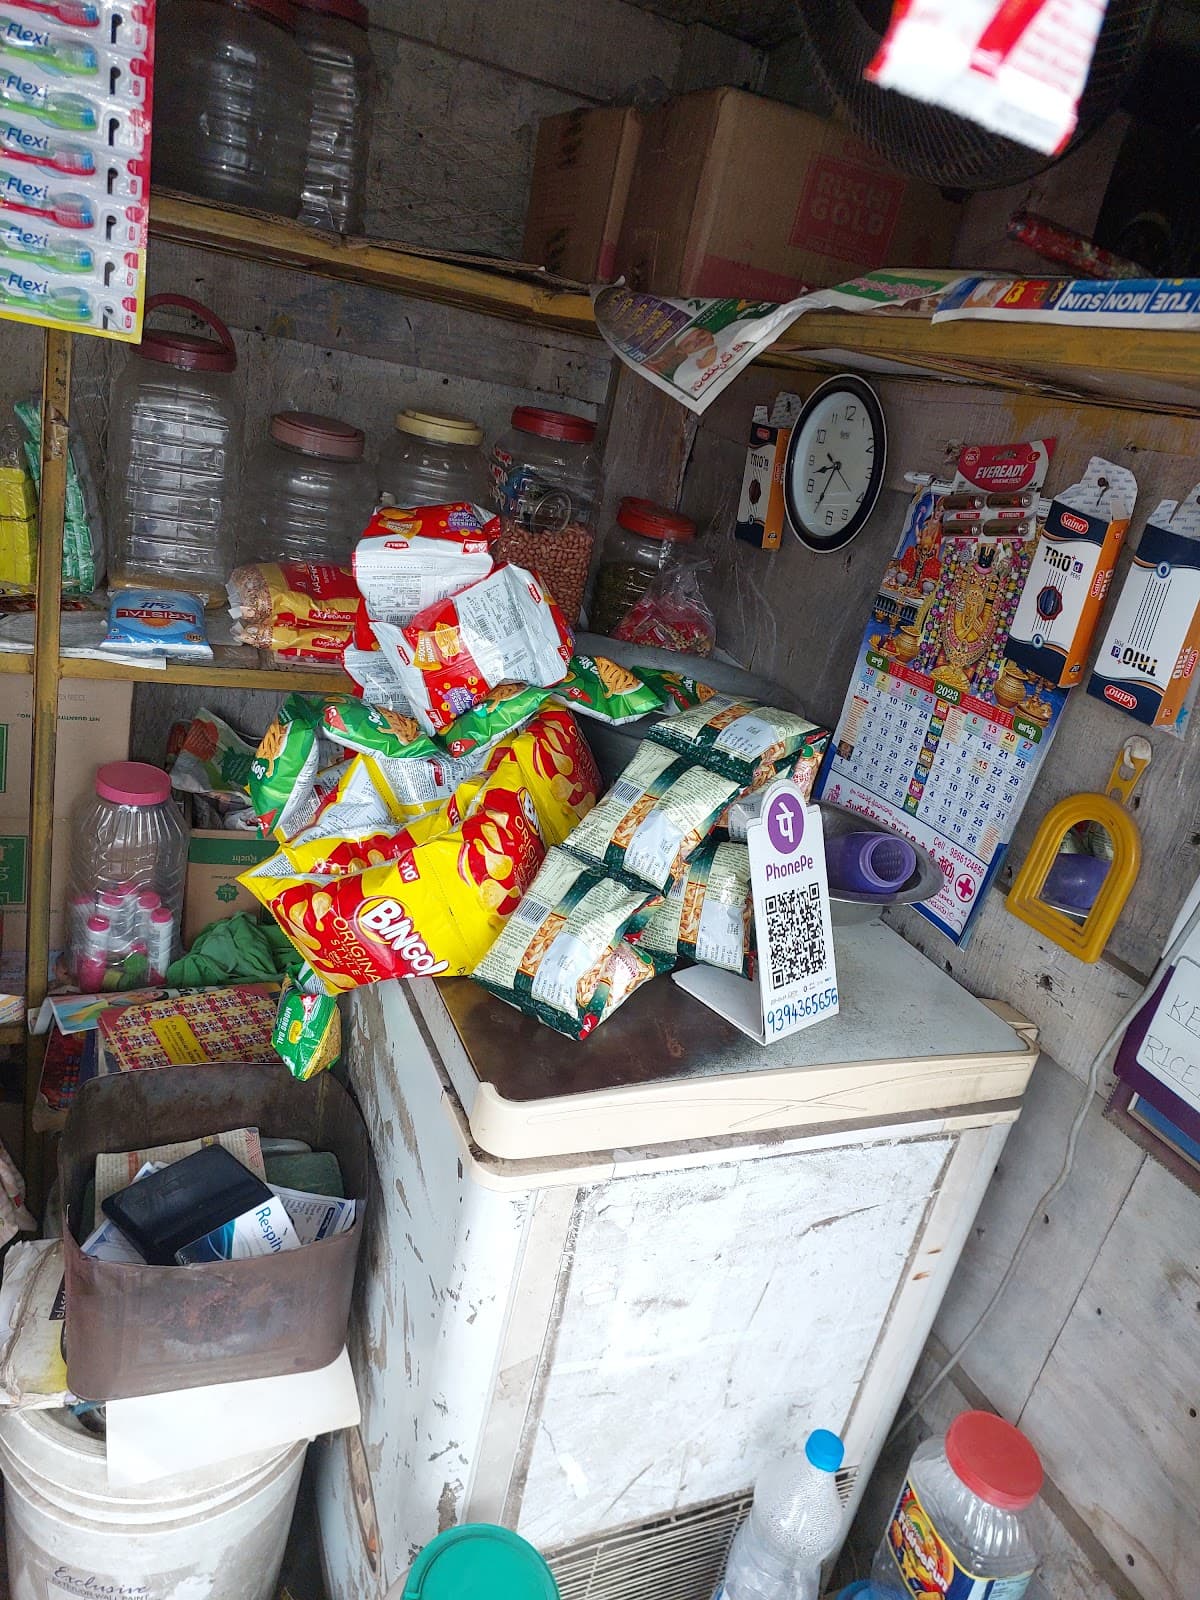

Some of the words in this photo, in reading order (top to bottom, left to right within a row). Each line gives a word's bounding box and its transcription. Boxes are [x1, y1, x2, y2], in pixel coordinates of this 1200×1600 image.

[7, 24, 50, 46] Flexi
[6, 128, 50, 150] Flexi
[6, 177, 50, 199] Flexi
[8, 274, 49, 293] Flexi
[1063, 290, 1105, 310] SUN
[1104, 291, 1146, 310] MON
[1150, 291, 1191, 311] TUE
[844, 405, 856, 421] 12
[816, 429, 827, 444] 10
[866, 437, 875, 453] 2
[866, 467, 873, 480] 3
[975, 464, 1029, 480] EVEREADY
[856, 492, 865, 503] 4
[1062, 514, 1087, 532] Saino
[117, 608, 197, 623] KRISTAL
[866, 668, 874, 676] 30
[909, 688, 917, 696] 16
[924, 695, 932, 703] 23
[936, 685, 959, 700] 2023
[1106, 687, 1136, 707] Saino
[861, 683, 869, 691] 31
[889, 696, 898, 704] 10
[904, 703, 912, 712] 17
[919, 711, 928, 720] 24
[58, 714, 85, 722] QUANTIT
[900, 720, 907, 728] 18
[914, 727, 923, 735] 25
[880, 728, 888, 736] 12
[894, 735, 903, 743] 19
[908, 743, 918, 752] 26
[988, 725, 997, 734] 13
[1005, 733, 1015, 742] 20
[1022, 741, 1033, 750] 27
[875, 743, 883, 751] 13
[889, 751, 898, 759] 20
[904, 758, 914, 767] 27
[982, 741, 991, 750] 14
[999, 750, 1009, 759] 21
[1016, 759, 1026, 768] 28
[871, 758, 879, 766] 14
[884, 766, 893, 774] 21
[899, 774, 908, 782] 28
[979, 760, 988, 769] 15
[992, 767, 1002, 777] 22
[1009, 776, 1019, 786] 29
[879, 781, 888, 789] 22
[894, 789, 903, 797] 29
[971, 775, 979, 784] 16
[986, 784, 996, 794] 23
[1002, 794, 1012, 803] 30
[949, 782, 957, 792] 10
[965, 792, 974, 800] 17
[980, 801, 990, 810] 24
[996, 810, 1005, 820] 31
[776, 802, 794, 843] पे
[943, 799, 951, 807] 11
[959, 808, 968, 817] 18
[973, 817, 984, 827] 25
[938, 814, 947, 824] 12
[953, 824, 961, 833] 19
[968, 834, 977, 843] 26
[766, 855, 814, 882] PhonePe
[360, 896, 450, 978] BINGO!
[330, 938, 363, 977] STYLE
[331, 916, 382, 985] ORIGINA
[281, 1006, 292, 1031] MOONG
[767, 988, 838, 1034] 9394365656
[276, 1030, 286, 1044] DAL
[1146, 1034, 1200, 1086] RICE
[54, 1565, 153, 1594] Exclusive
